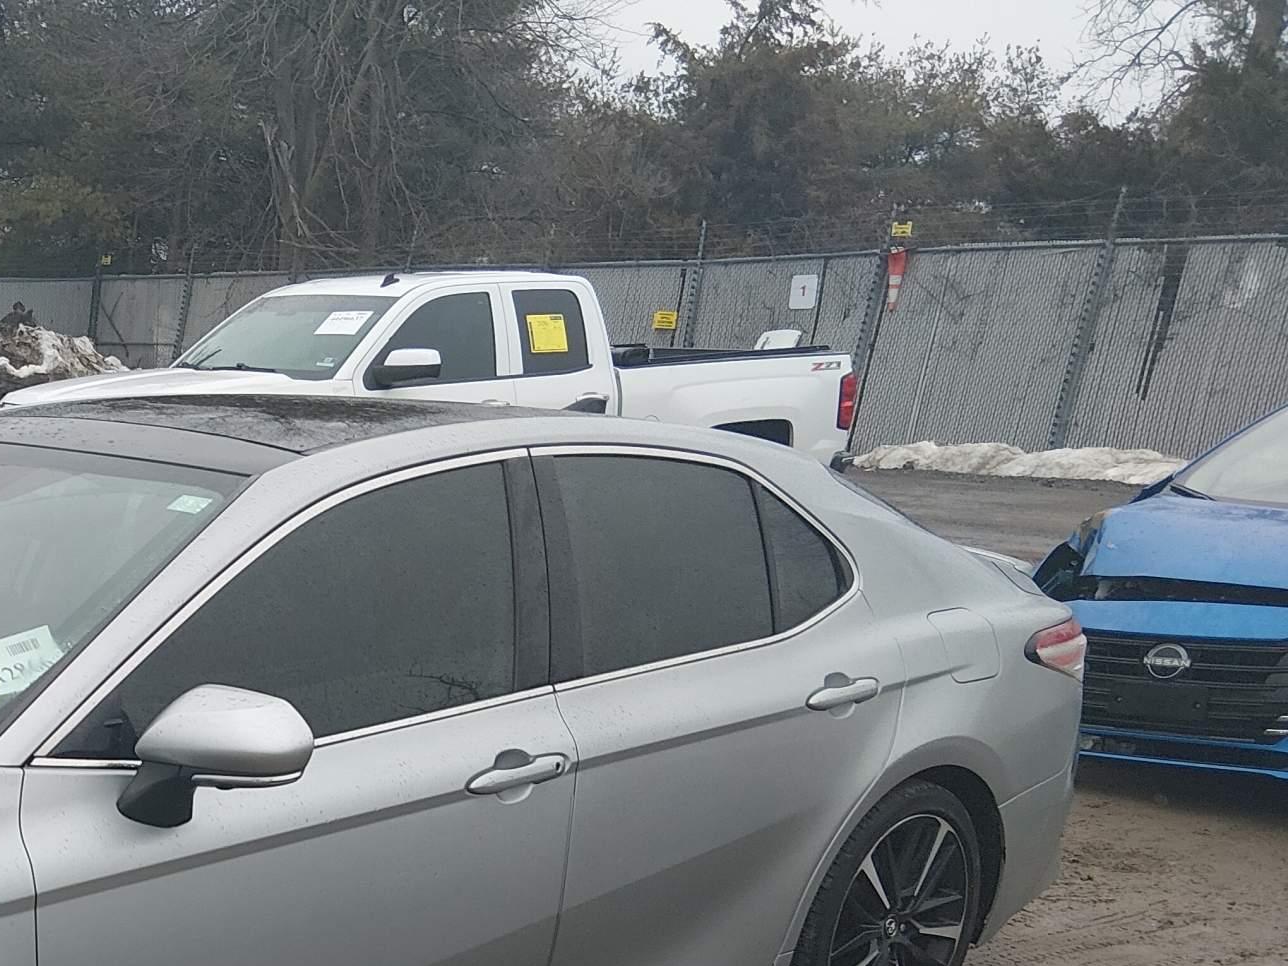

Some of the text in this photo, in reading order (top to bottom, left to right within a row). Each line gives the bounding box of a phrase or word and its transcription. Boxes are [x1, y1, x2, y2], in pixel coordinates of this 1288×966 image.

[799, 284, 807, 296] 1
[811, 361, 841, 372] Z71
[1143, 656, 1191, 668] NISSAN
